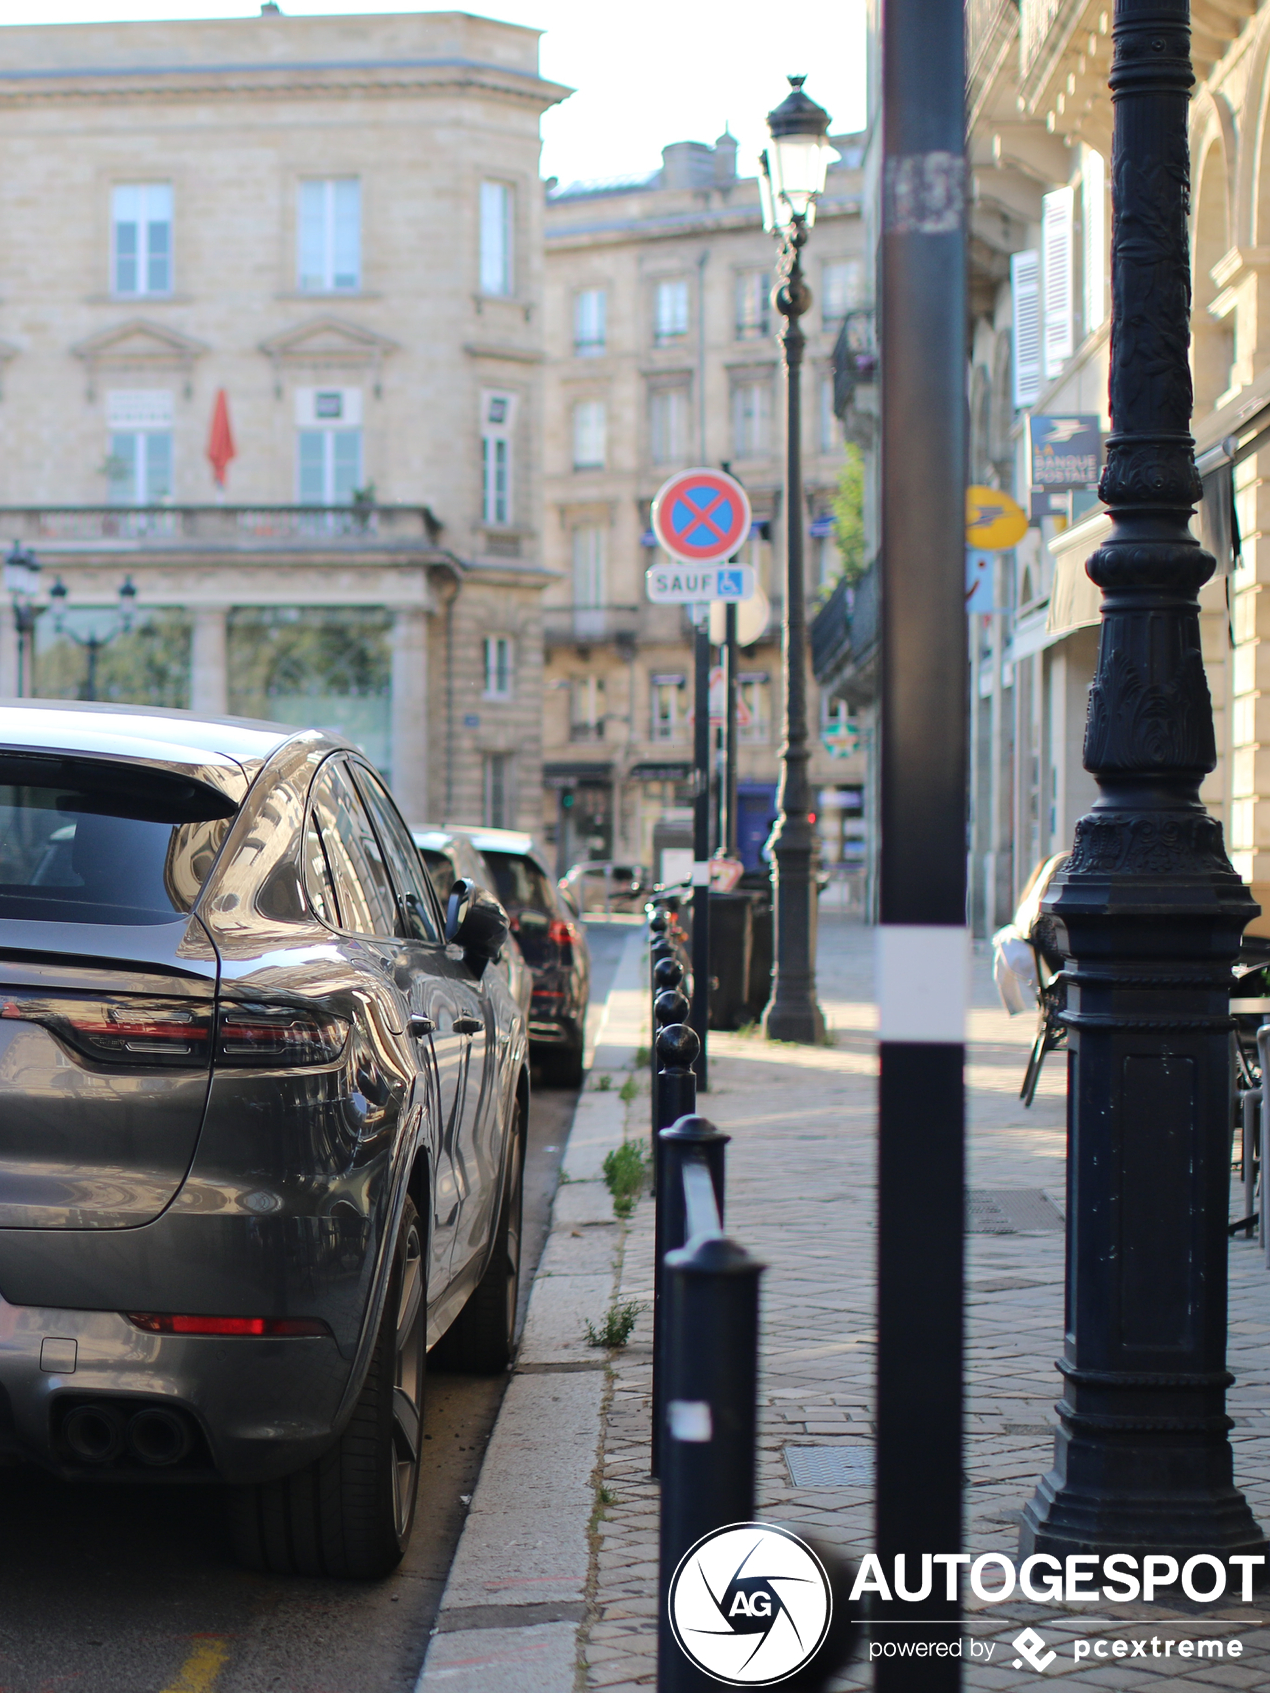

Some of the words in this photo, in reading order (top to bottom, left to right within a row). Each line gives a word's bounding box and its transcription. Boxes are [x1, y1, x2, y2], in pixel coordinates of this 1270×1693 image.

[1034, 454, 1097, 468] BANQUE
[1034, 468, 1097, 483] POSTALE
[657, 574, 712, 592] SAUF
